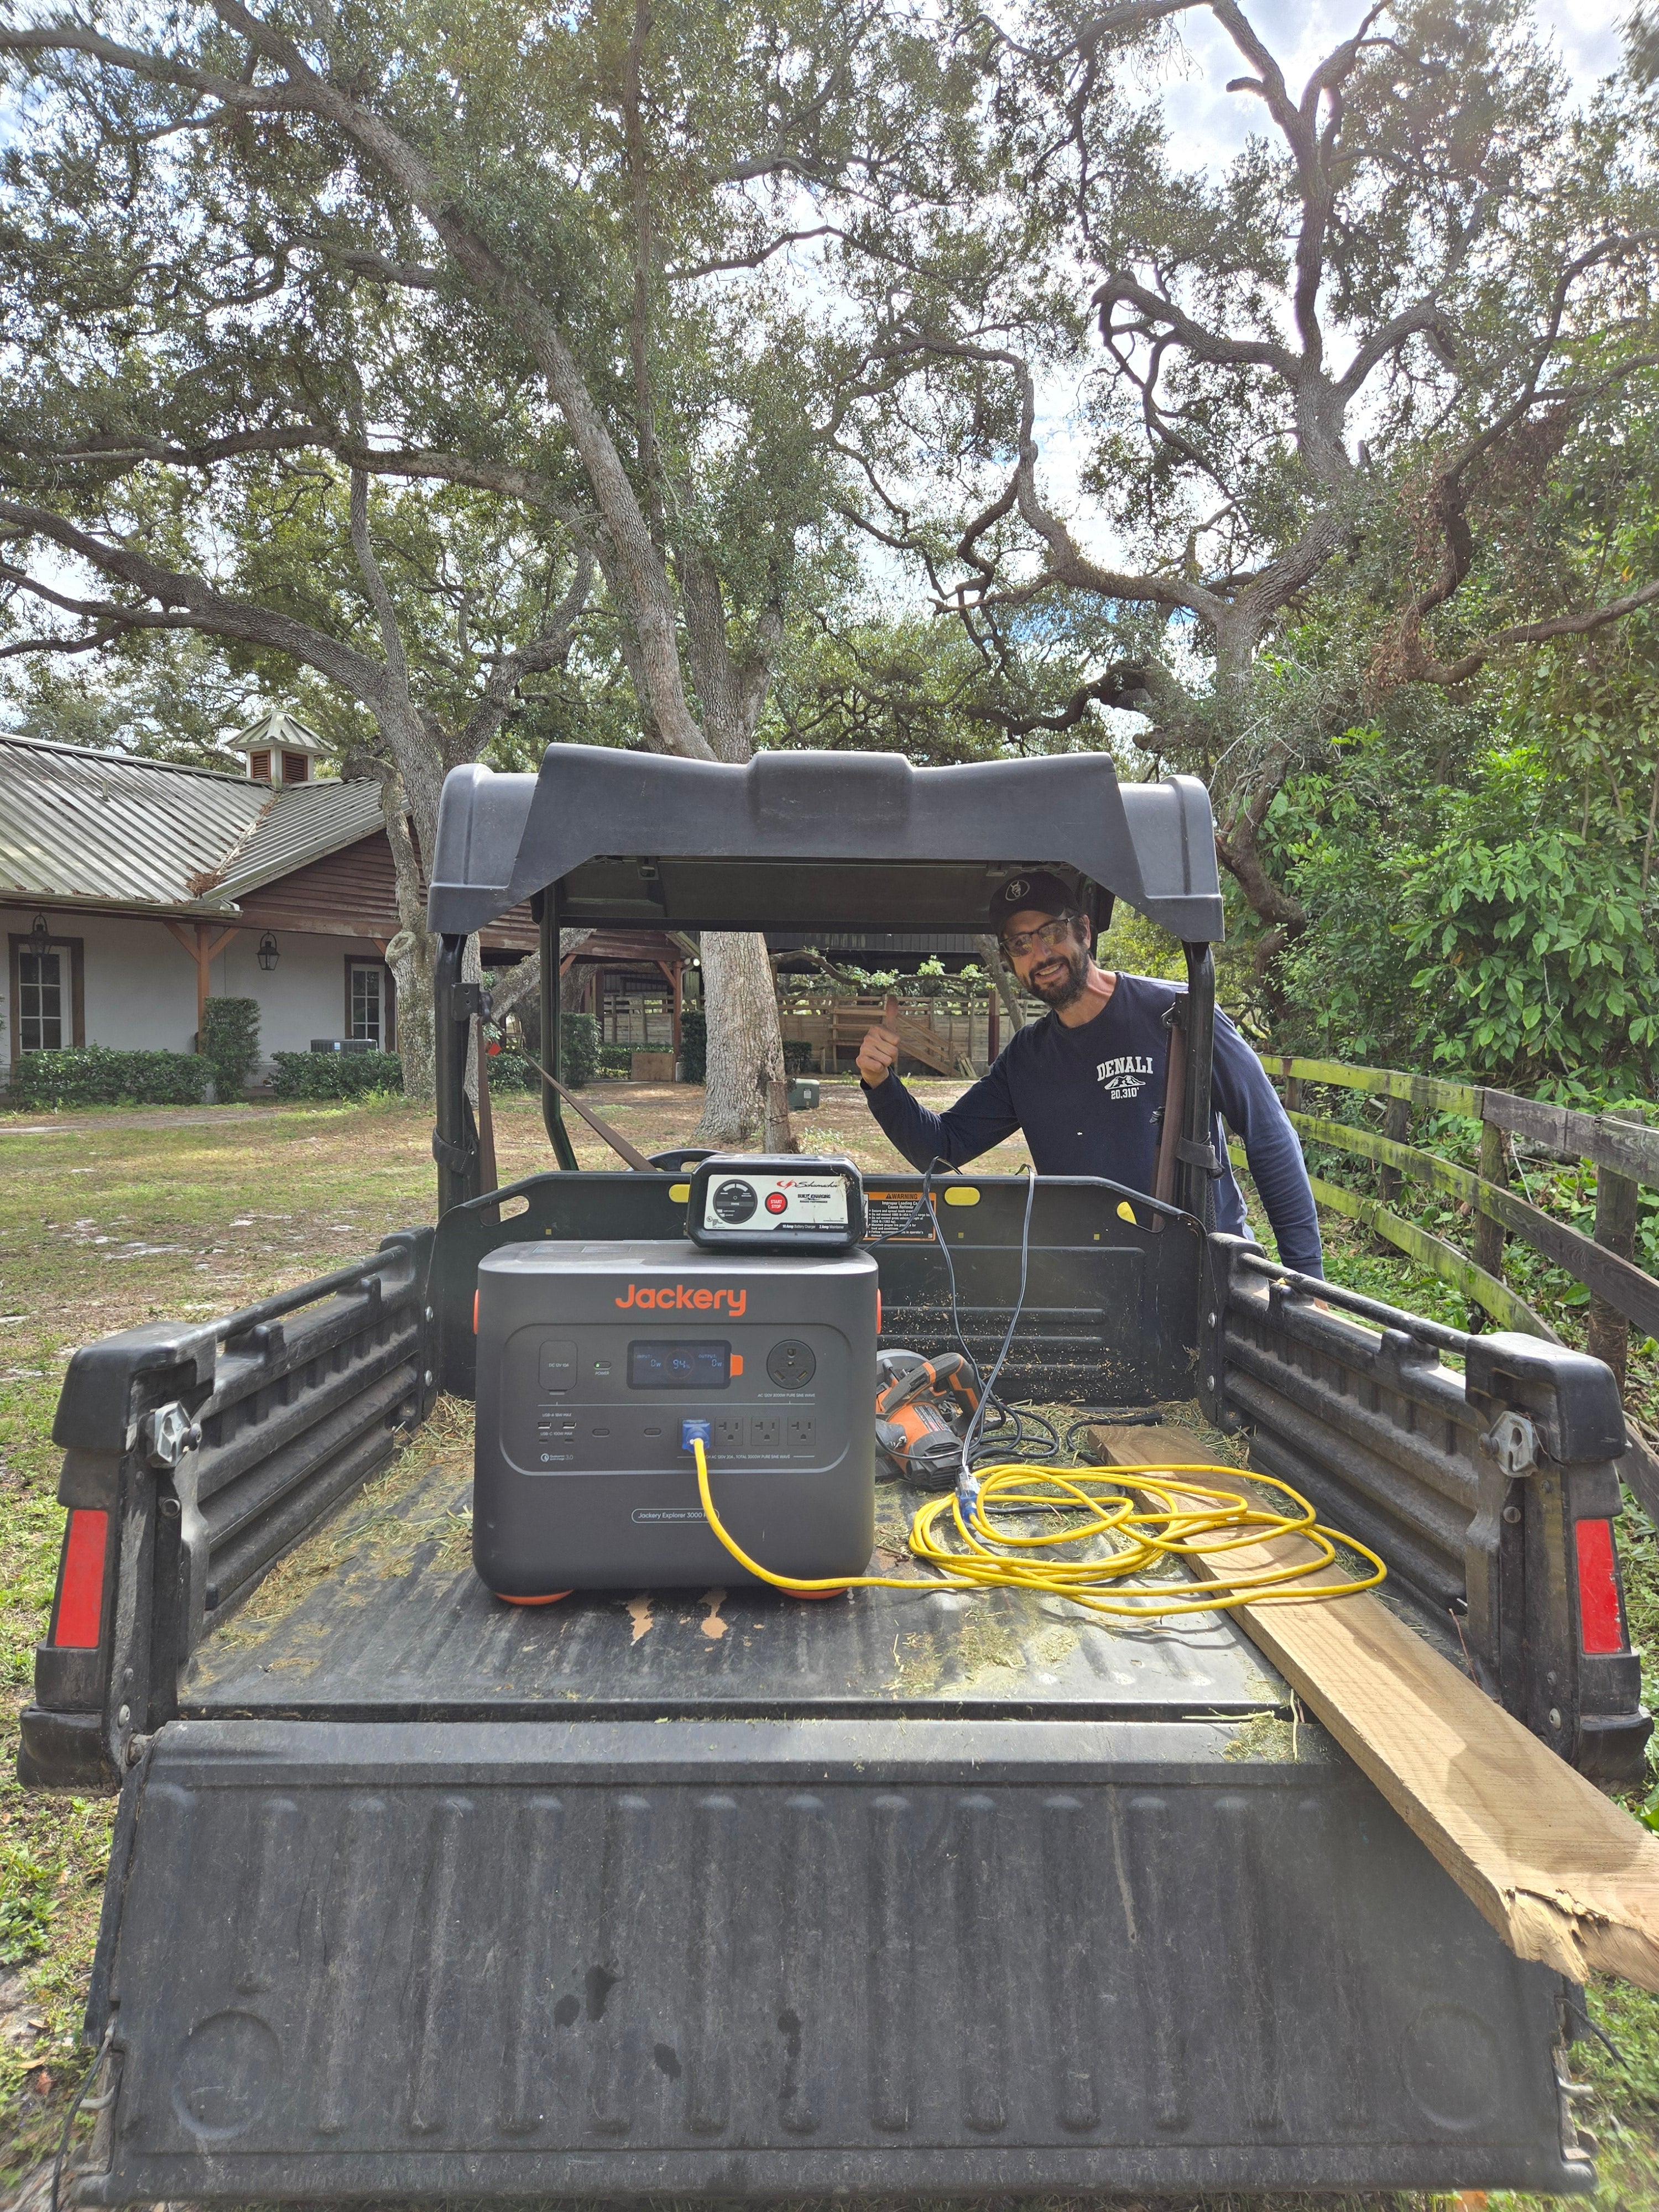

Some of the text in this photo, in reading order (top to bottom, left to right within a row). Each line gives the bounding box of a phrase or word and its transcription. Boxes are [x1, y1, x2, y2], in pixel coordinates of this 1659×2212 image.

[1096, 1056, 1154, 1082] DENALI
[615, 1284, 747, 1317] Jackery
[672, 1359, 691, 1369] 94%
